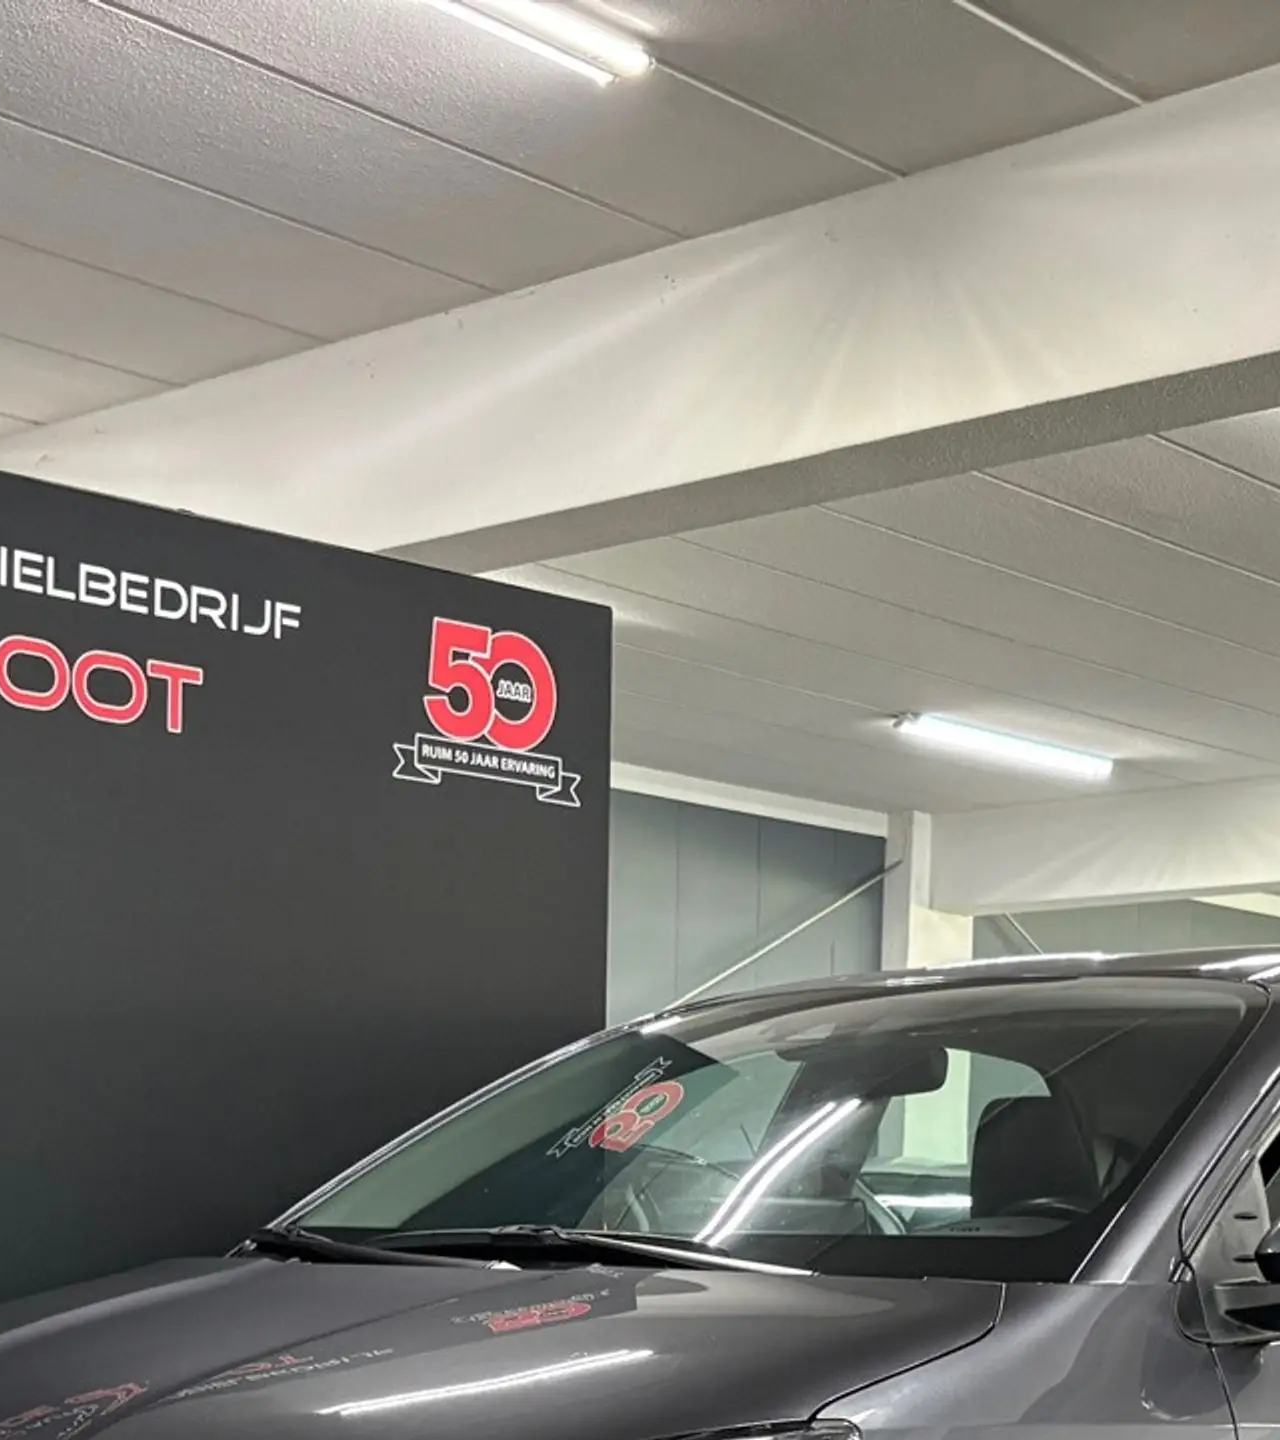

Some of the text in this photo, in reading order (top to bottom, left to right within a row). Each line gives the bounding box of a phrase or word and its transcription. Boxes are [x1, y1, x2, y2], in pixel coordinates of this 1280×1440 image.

[423, 616, 558, 752] 50
[496, 678, 532, 703] JAAR
[422, 744, 556, 779] RUIM 50 JAAR ERVARING
